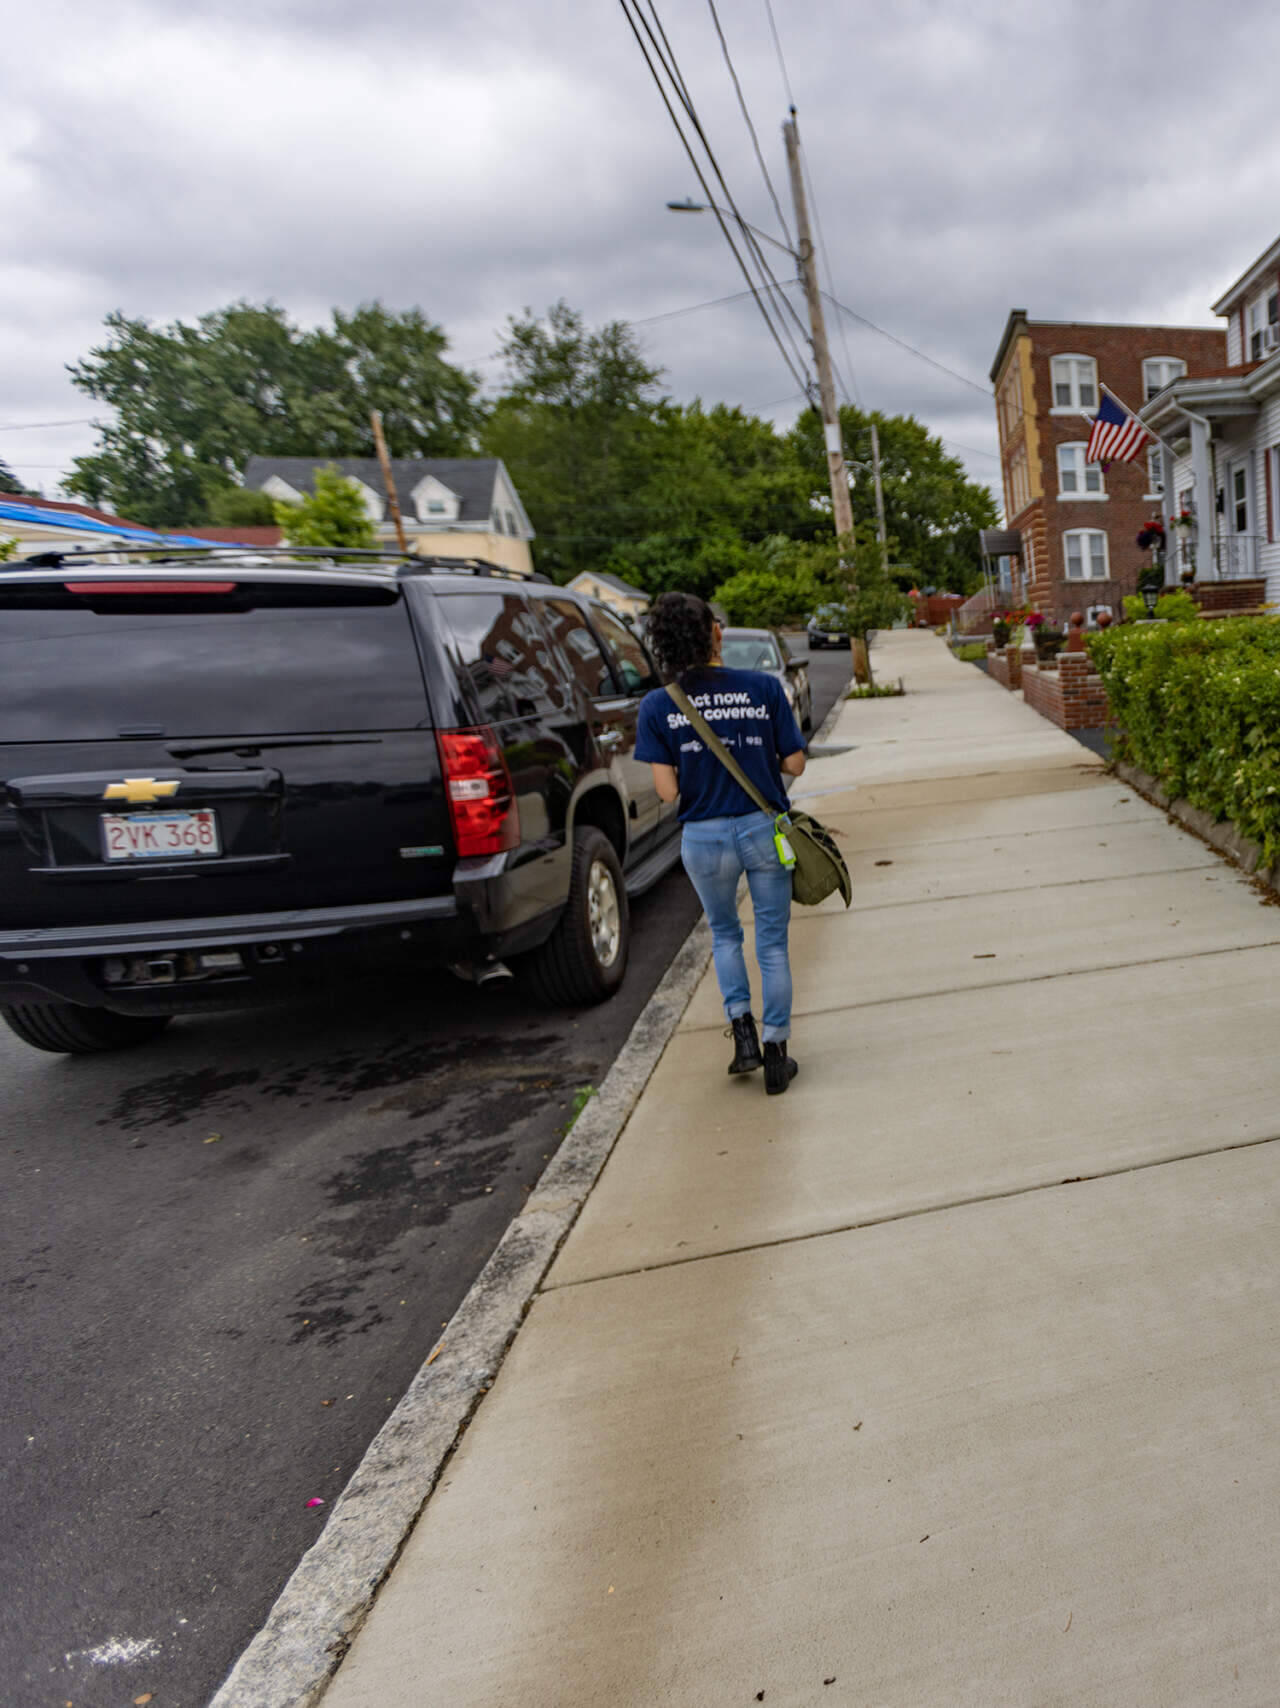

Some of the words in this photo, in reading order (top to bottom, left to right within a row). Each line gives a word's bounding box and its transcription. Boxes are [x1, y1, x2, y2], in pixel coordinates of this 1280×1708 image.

[713, 692, 751, 706] now.
[703, 704, 770, 721] covered.
[109, 824, 160, 850] 2VK
[164, 822, 214, 847] 368
